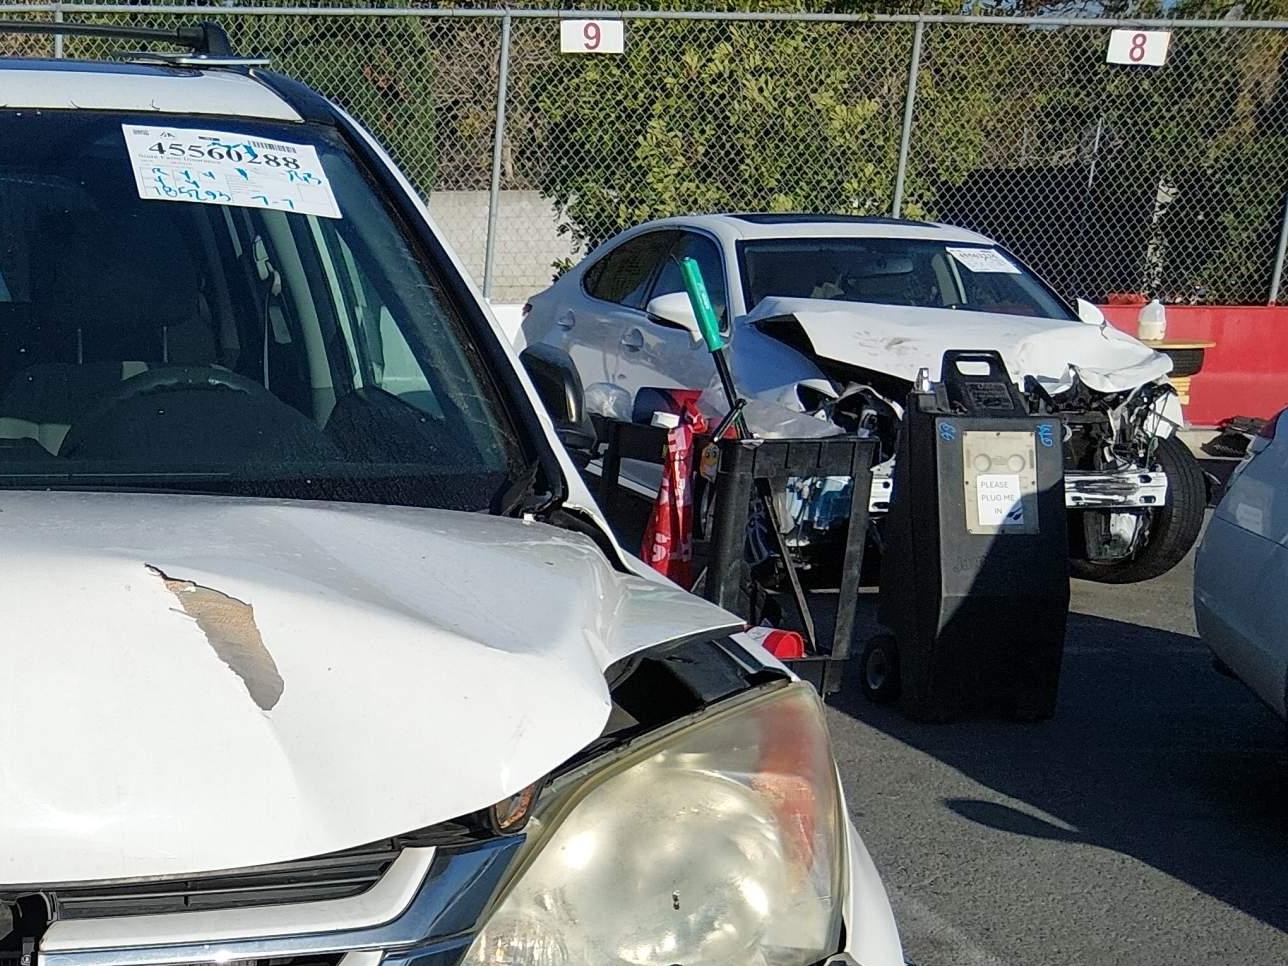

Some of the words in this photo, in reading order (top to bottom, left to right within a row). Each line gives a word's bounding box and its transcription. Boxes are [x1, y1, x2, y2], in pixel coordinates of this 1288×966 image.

[583, 22, 601, 50] 9
[1129, 33, 1147, 62] 8
[148, 141, 301, 170] 45560288
[980, 481, 1009, 489] PLEASE
